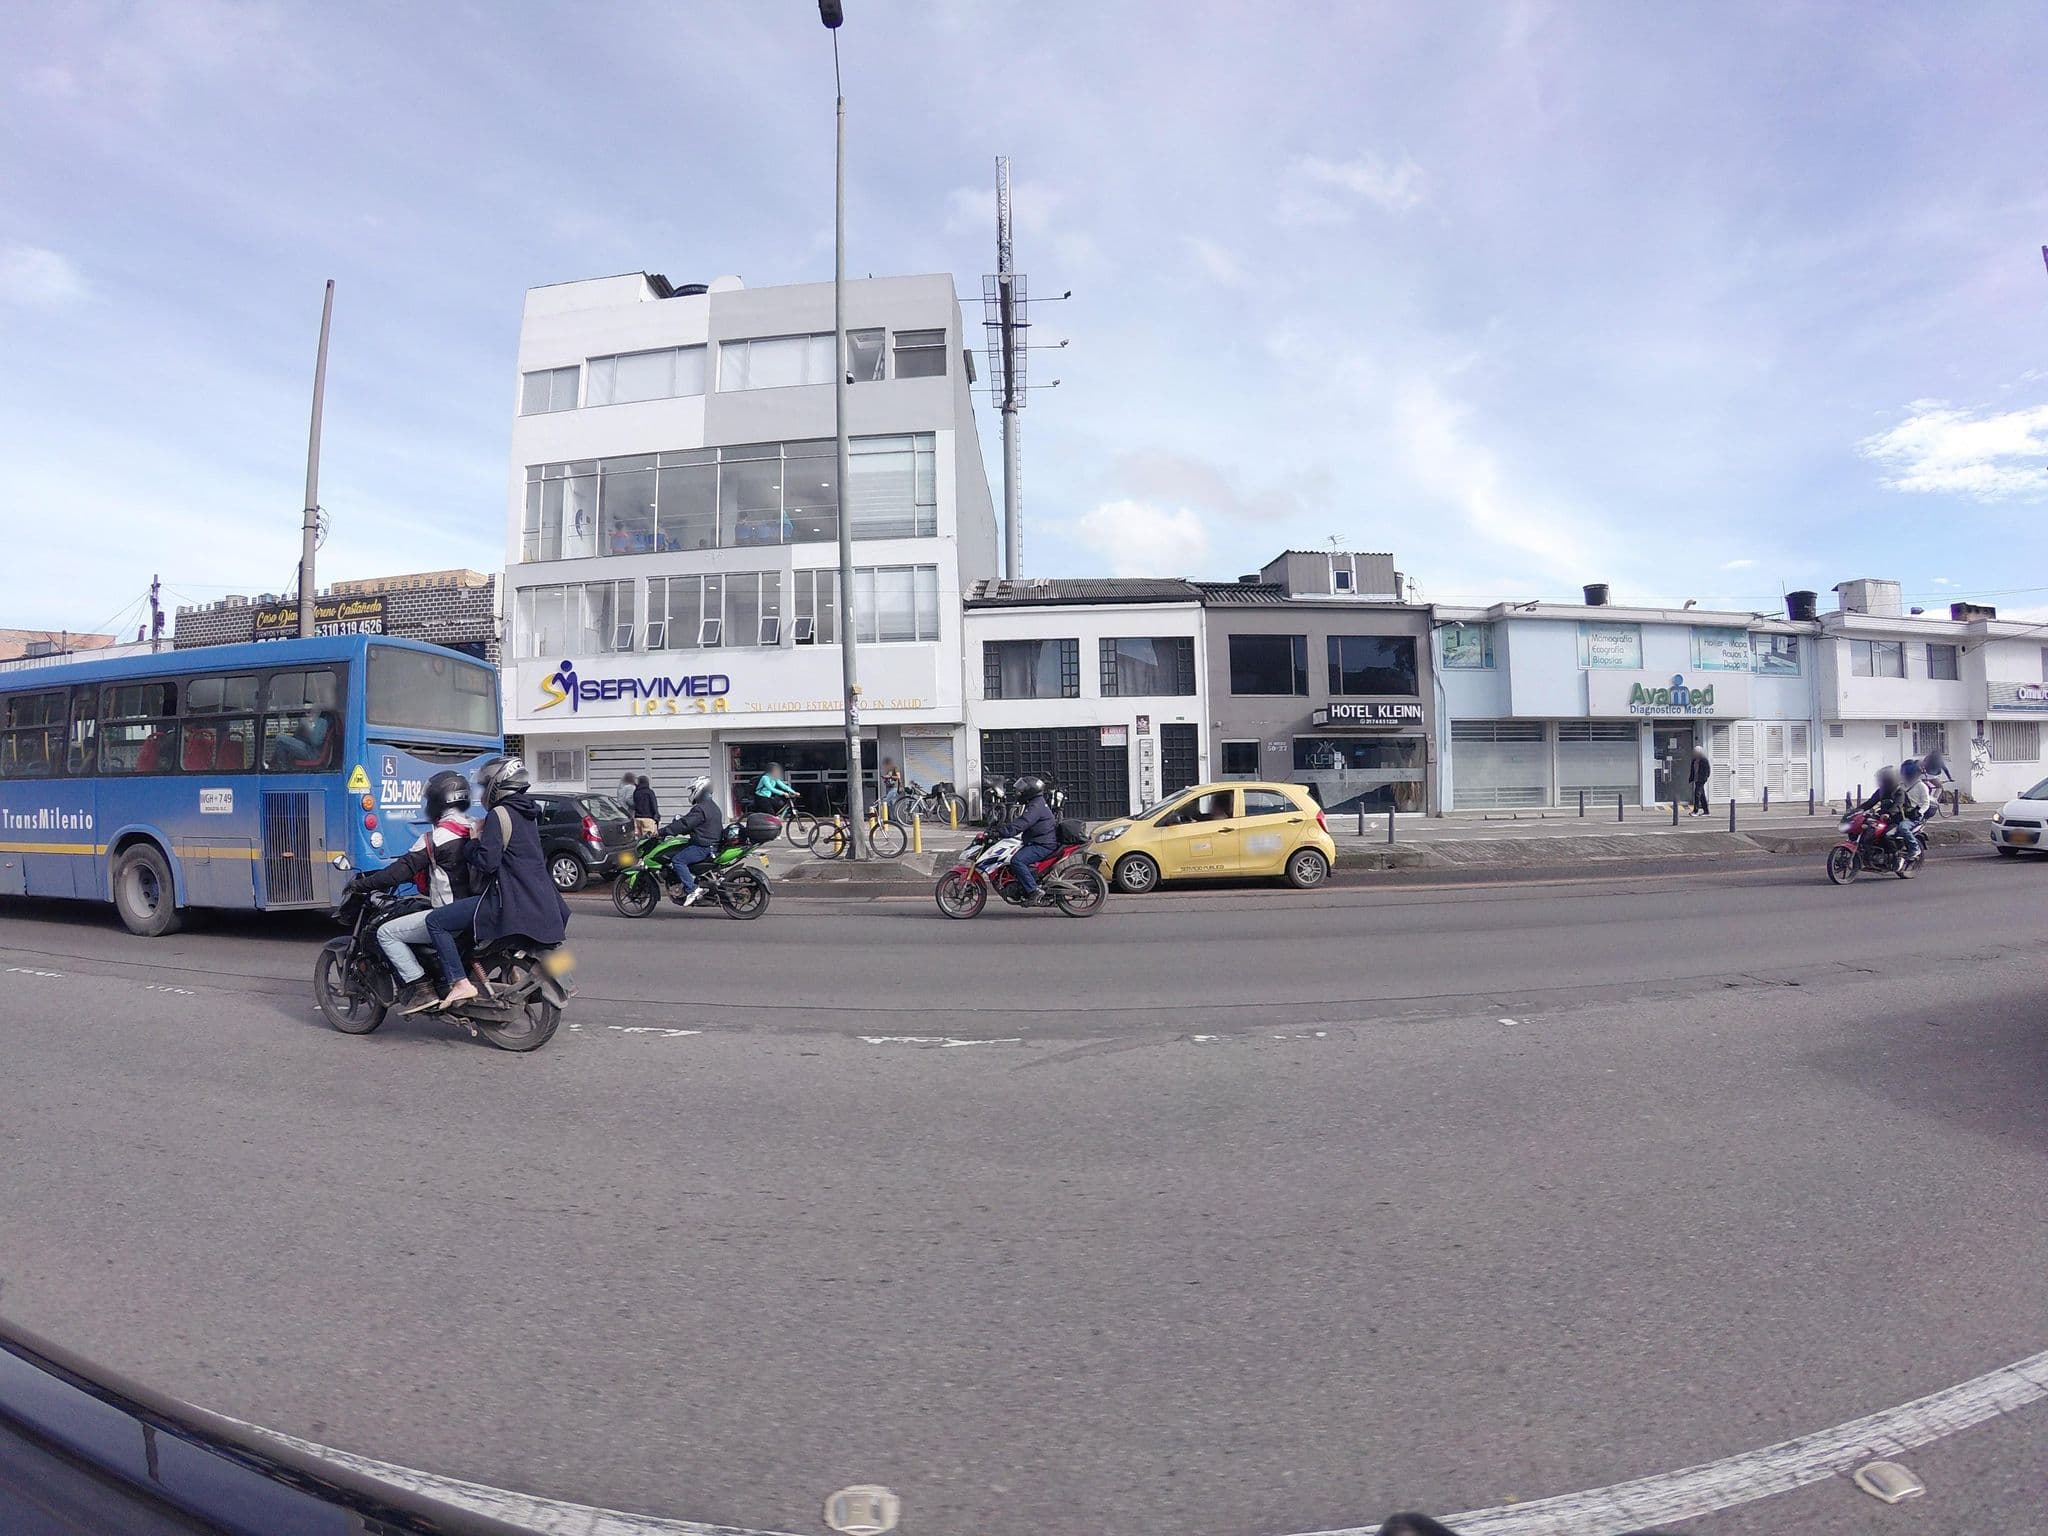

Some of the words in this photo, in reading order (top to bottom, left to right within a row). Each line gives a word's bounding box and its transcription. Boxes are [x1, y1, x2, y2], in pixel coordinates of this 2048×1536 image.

[256, 611, 277, 628] Casa
[337, 598, 382, 620] Castañeda
[321, 623, 338, 637] 310
[340, 621, 357, 636] 319
[358, 619, 382, 635] 4526
[579, 674, 731, 701] SERVIMED
[1630, 675, 1714, 706] Avamed
[873, 699, 885, 710] EN
[1331, 704, 1373, 718] HOTEL
[1378, 704, 1421, 718] KLEINN
[380, 779, 422, 803] Z50-7038
[2, 806, 93, 830] TransMilenio
